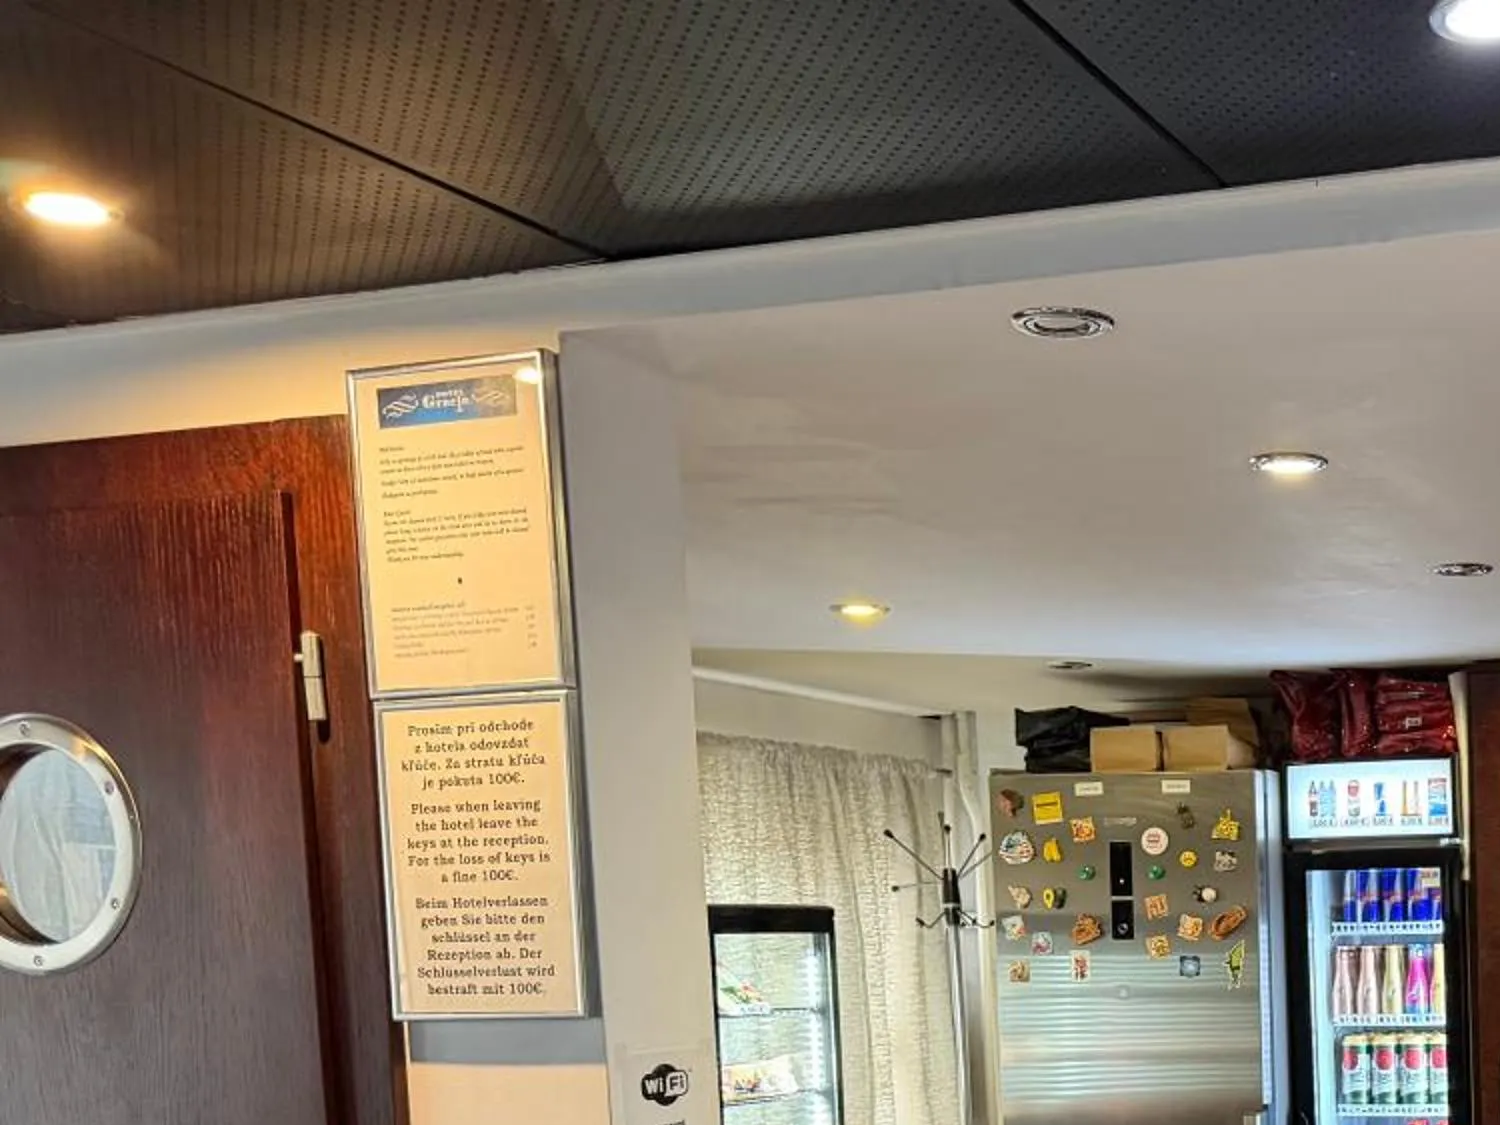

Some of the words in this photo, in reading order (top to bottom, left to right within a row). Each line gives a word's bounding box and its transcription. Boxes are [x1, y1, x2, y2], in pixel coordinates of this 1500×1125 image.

[480, 719, 533, 732] odchode
[445, 758, 460, 769] Za
[465, 756, 504, 768] stratu
[422, 776, 434, 790] je
[438, 775, 483, 791] pokuta
[489, 772, 525, 785] 100€.
[411, 803, 451, 814] Please
[455, 801, 489, 812] when
[493, 799, 541, 812] leaving
[415, 820, 437, 832] the
[441, 818, 474, 830] hotel
[479, 818, 512, 829] leave
[516, 816, 538, 827] the
[407, 838, 436, 852] keys
[440, 839, 453, 849] at
[457, 836, 479, 847] the
[483, 834, 549, 848] reception.
[408, 855, 429, 866] For
[433, 854, 455, 865] the
[459, 853, 484, 865] loss
[488, 852, 501, 864] of
[505, 851, 535, 866] keys
[539, 850, 550, 862] is
[452, 871, 477, 883] fine
[415, 897, 449, 909] Beim
[452, 895, 549, 909] Hotelverlassen
[421, 915, 457, 929] geben
[461, 913, 482, 925] Sie
[485, 913, 517, 925] bitte
[521, 912, 545, 924] den
[495, 933, 510, 942] an
[514, 930, 536, 941] der
[427, 949, 492, 963] Rezeption
[495, 948, 516, 959] ab.
[519, 947, 542, 959] Der
[526, 964, 555, 977] wird
[427, 983, 478, 995] bestraft
[482, 983, 505, 995] mit
[643, 1072, 688, 1097] WiFi
